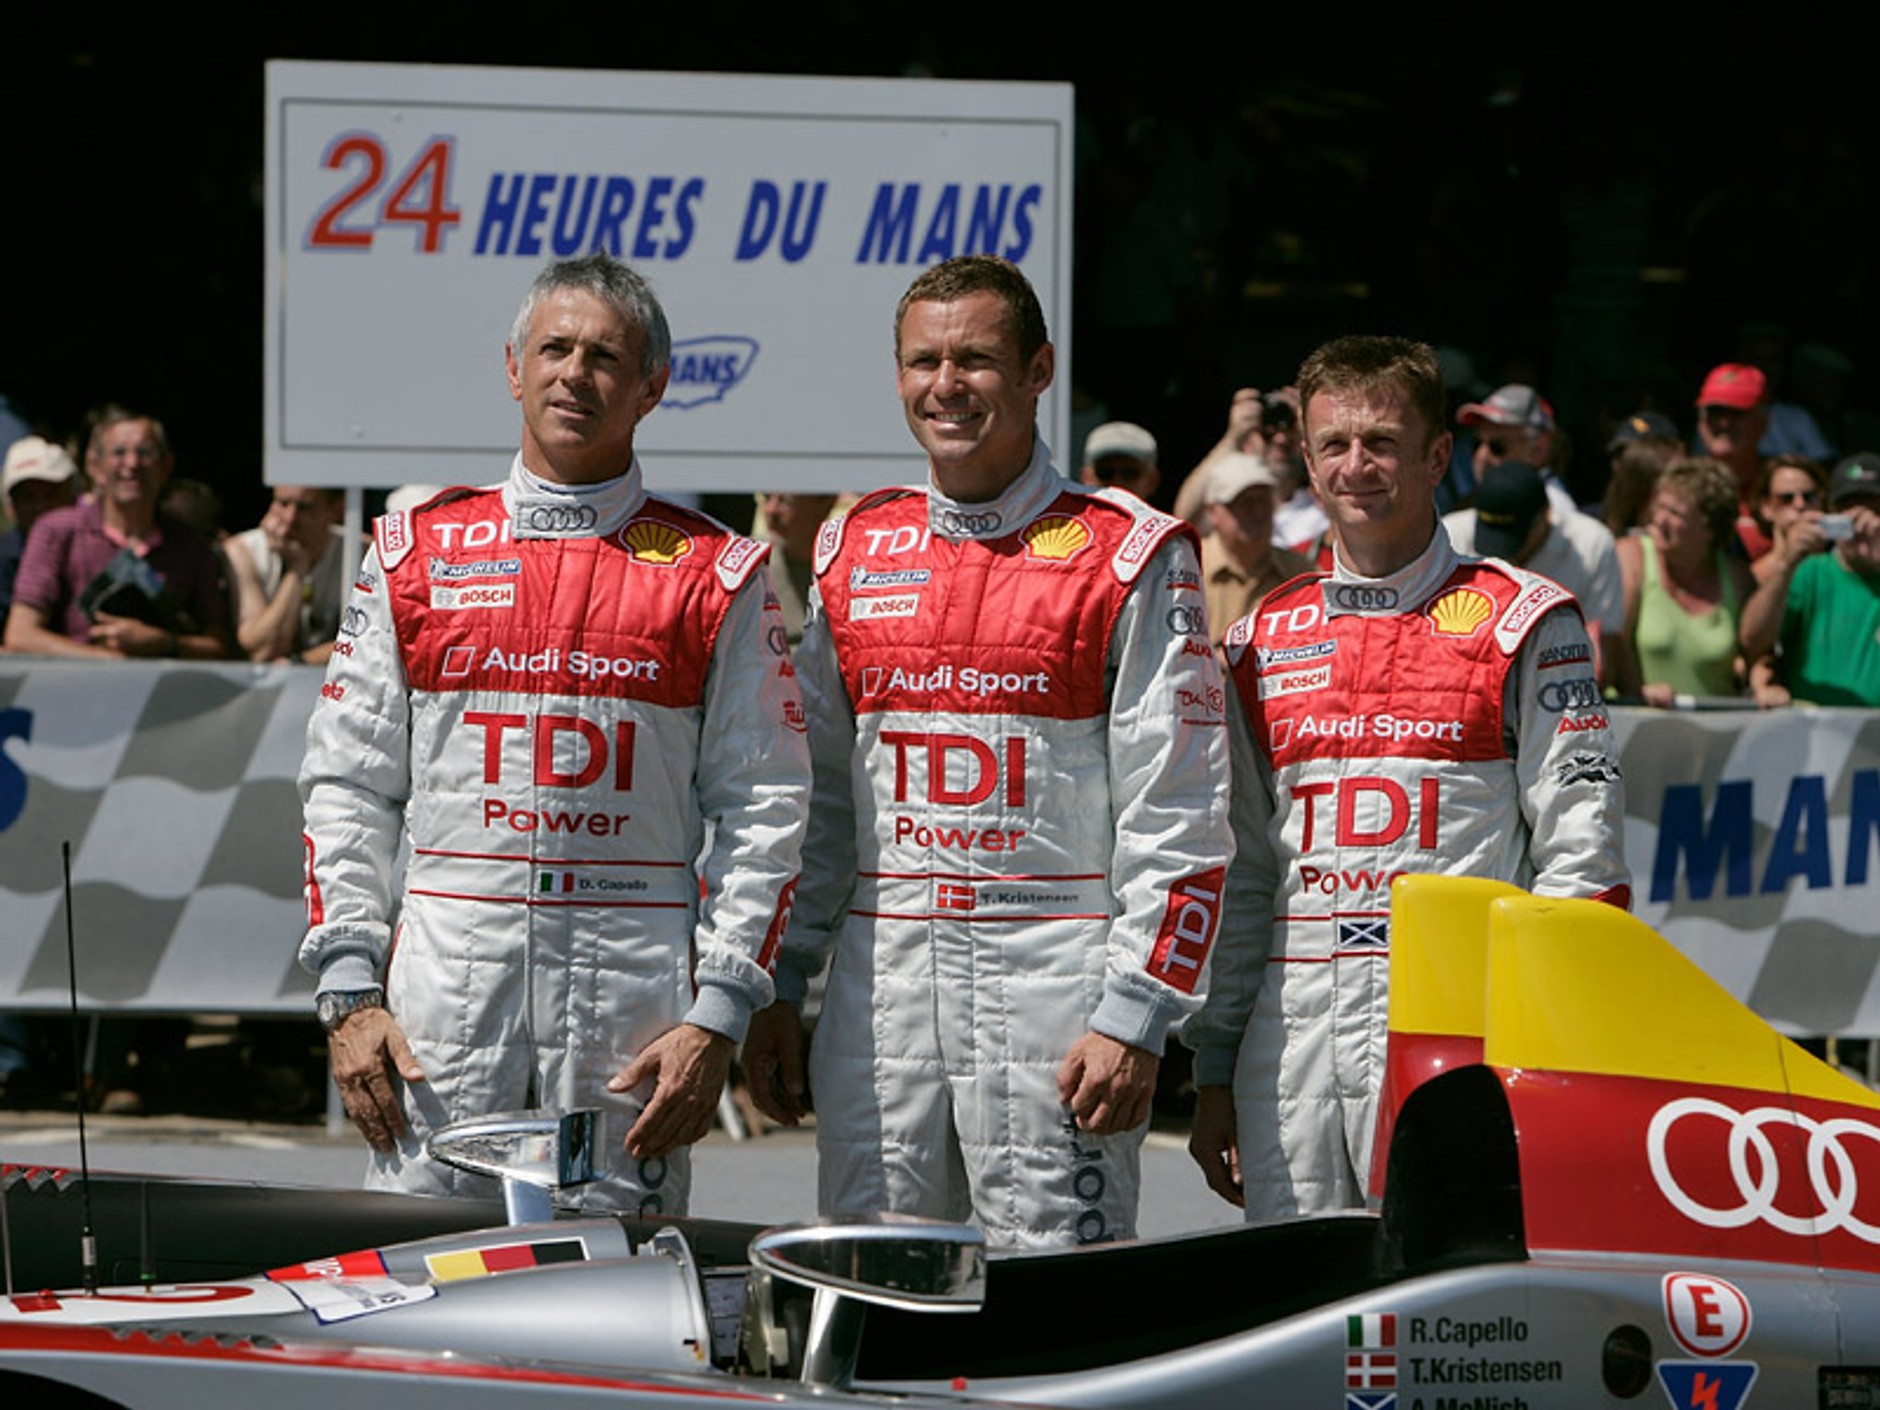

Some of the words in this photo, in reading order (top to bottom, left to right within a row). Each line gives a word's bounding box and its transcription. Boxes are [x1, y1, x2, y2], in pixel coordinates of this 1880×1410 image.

[303, 129, 460, 254] 24
[473, 173, 704, 258] HEURES
[735, 180, 828, 262] DU
[856, 182, 1043, 265] MANS
[432, 519, 511, 549] TDI
[865, 526, 931, 556] TDI
[459, 589, 511, 605] BOSCH
[870, 599, 914, 615] BOSCH
[482, 648, 560, 674] Audi
[568, 651, 659, 681] Sport
[888, 665, 952, 693] Audi
[959, 668, 1049, 698] Sport
[1280, 672, 1327, 691] BOSCH
[1297, 714, 1365, 739] Audi
[1373, 714, 1463, 743] Sport
[463, 711, 636, 791] TDI
[880, 730, 1026, 807] TDI
[483, 798, 630, 836] Power
[1291, 776, 1439, 853] TDI
[895, 815, 1025, 853] Power
[1299, 865, 1410, 895] Pow
[980, 892, 996, 904] T.
[1161, 885, 1218, 975] TDI
[1686, 1284, 1724, 1338] E
[1409, 1316, 1529, 1348] R.Capello
[1409, 1356, 1563, 1384] T.Kristensen
